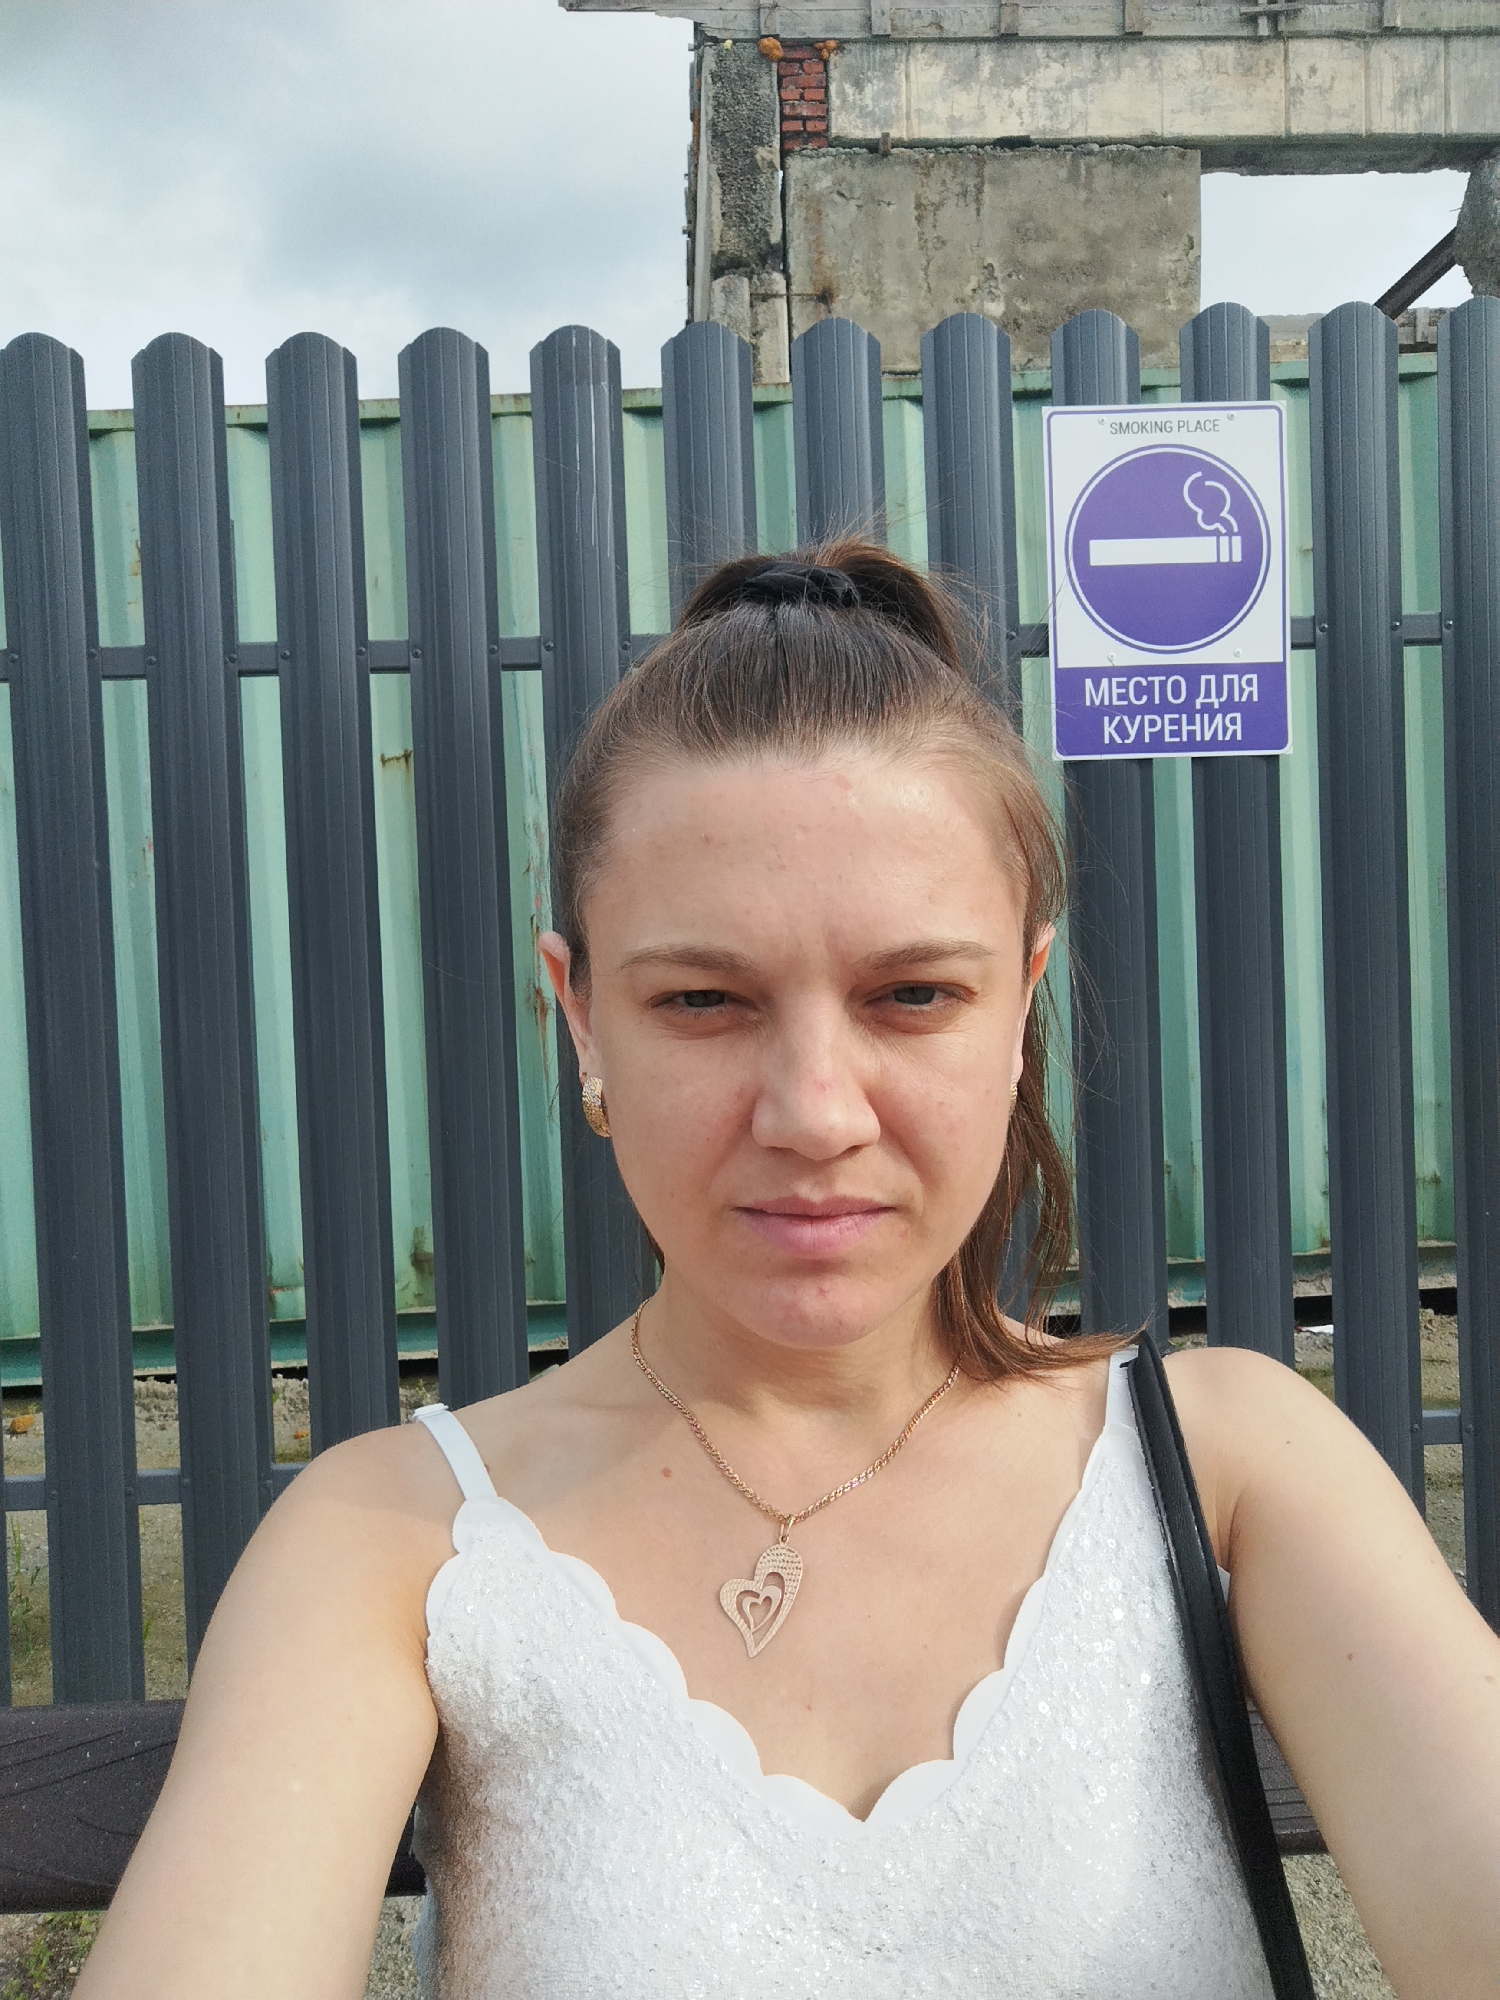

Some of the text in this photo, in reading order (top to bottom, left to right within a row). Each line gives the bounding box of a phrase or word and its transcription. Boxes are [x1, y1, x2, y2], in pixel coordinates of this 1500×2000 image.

[1109, 418, 1220, 435] SMOKING PLACE
[1084, 674, 1259, 709] МЕСТО ДЛЯ
[1103, 712, 1242, 744] КУРЕНИЯ
